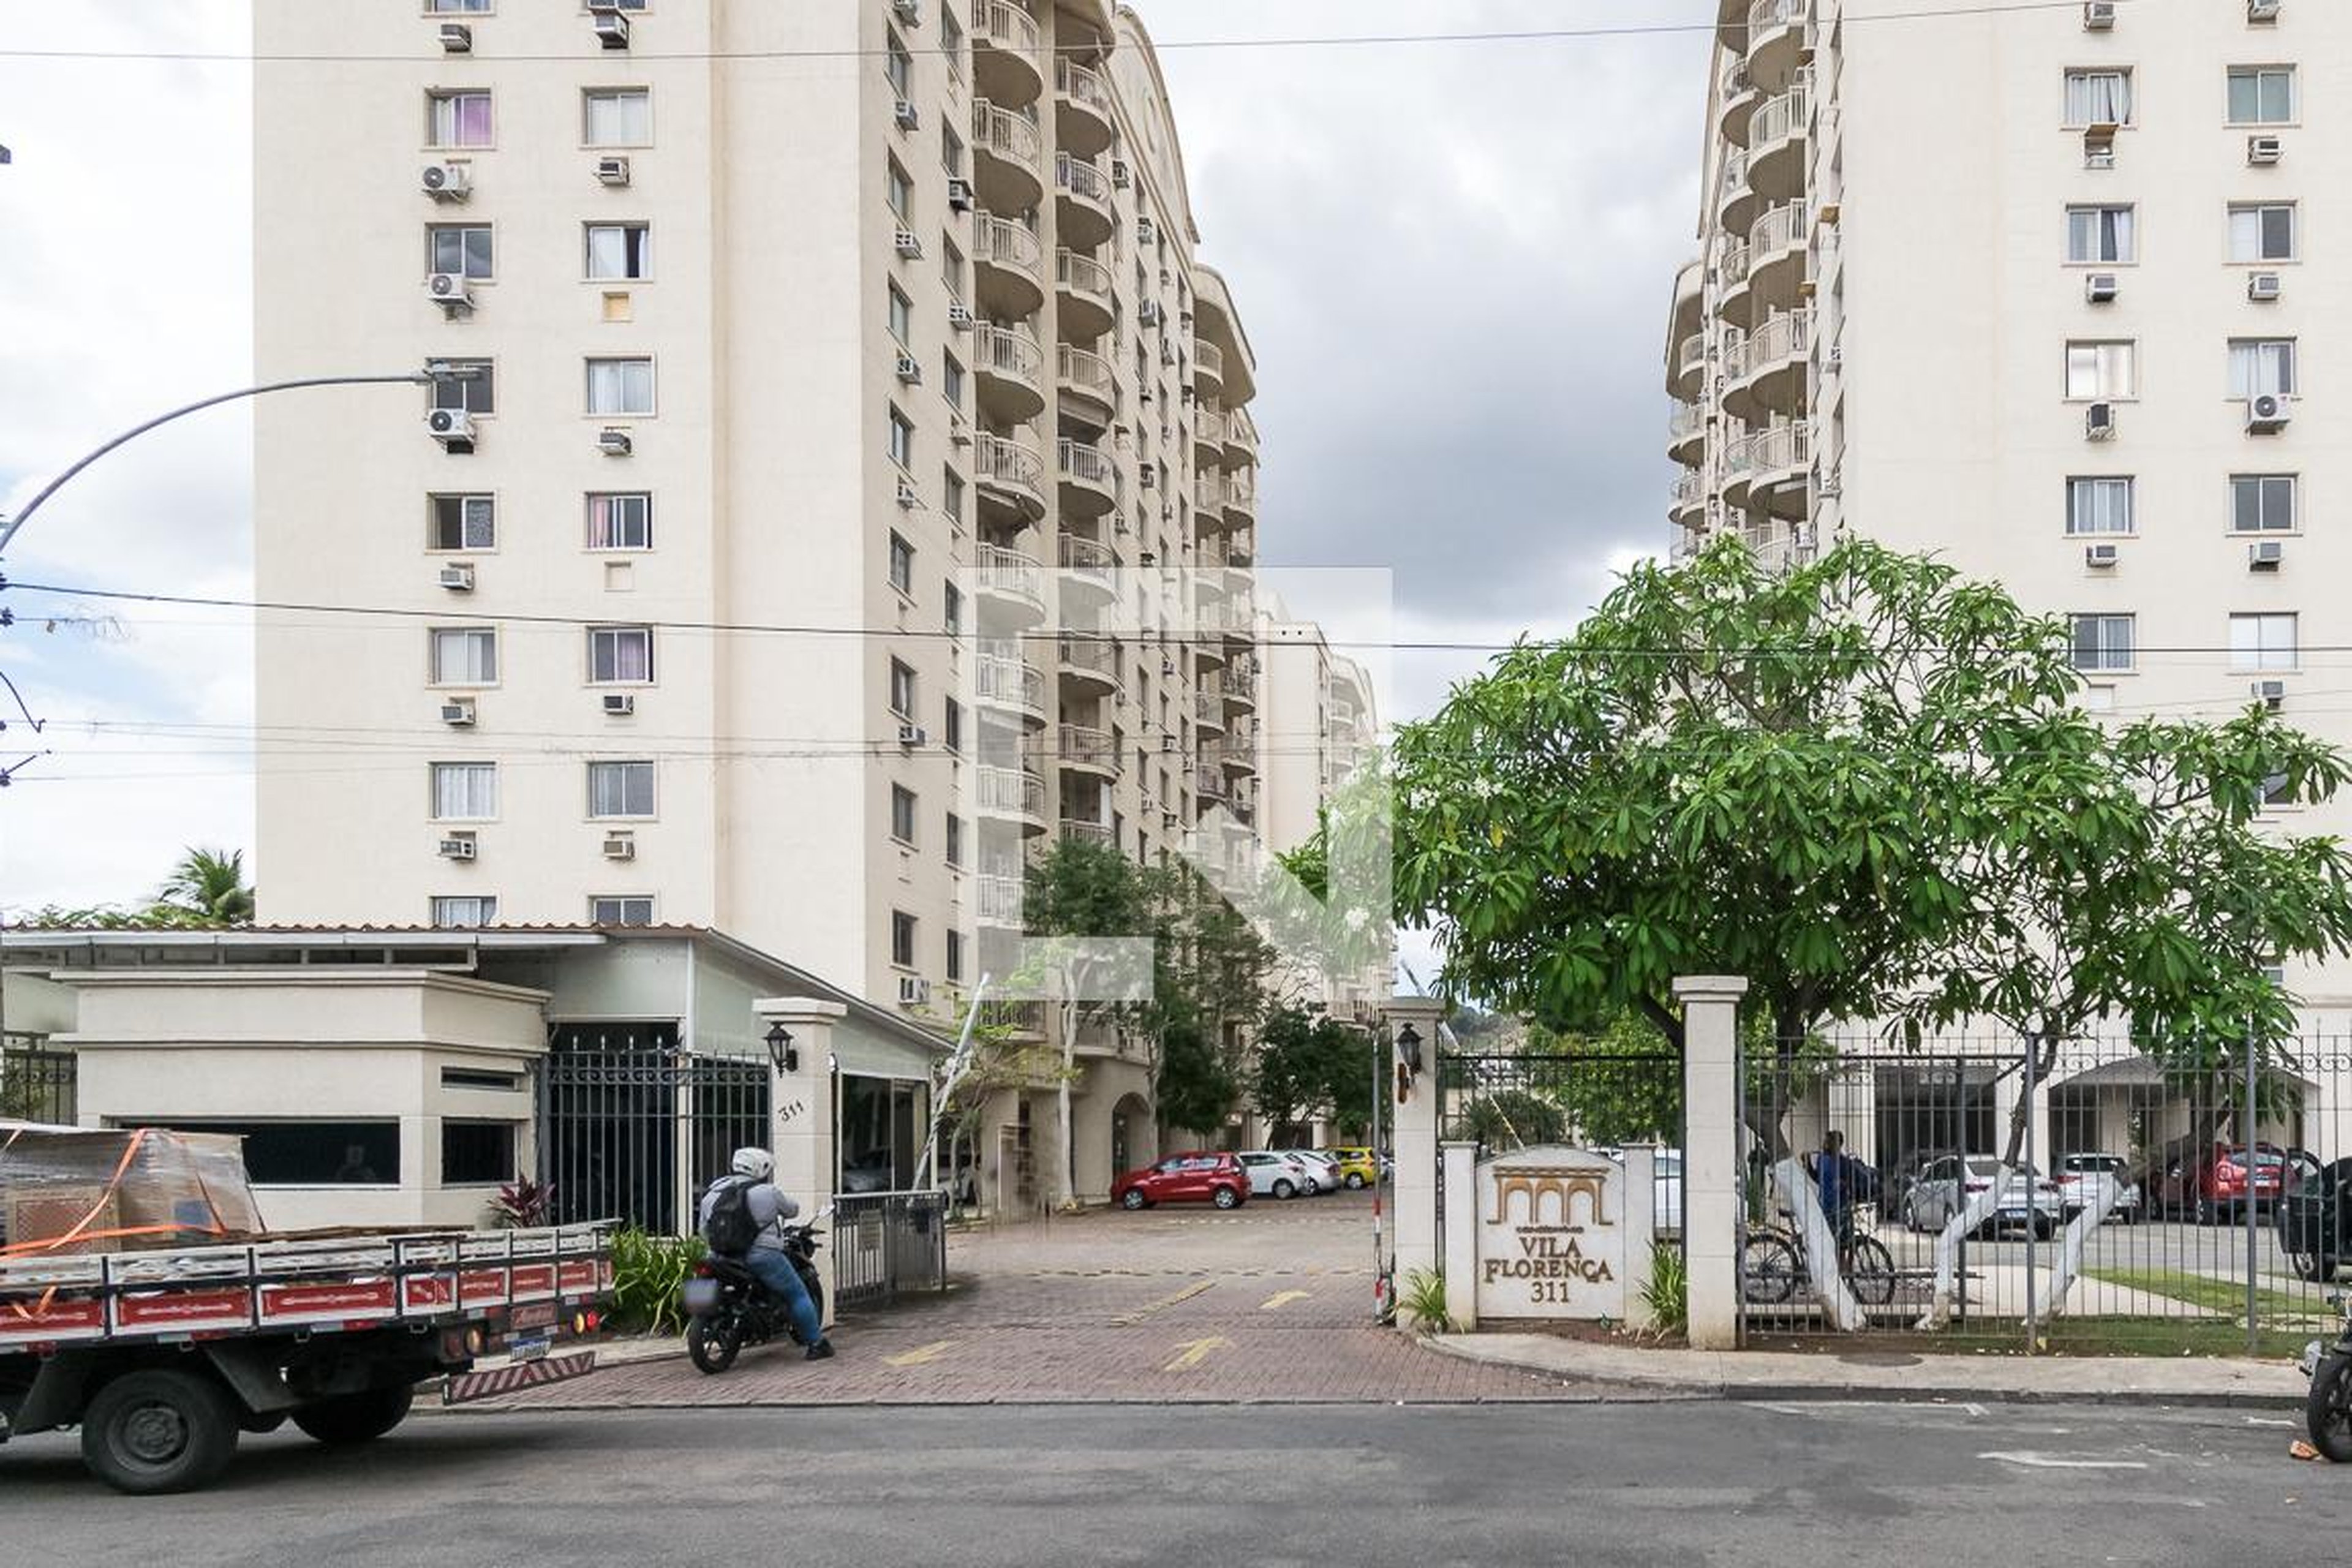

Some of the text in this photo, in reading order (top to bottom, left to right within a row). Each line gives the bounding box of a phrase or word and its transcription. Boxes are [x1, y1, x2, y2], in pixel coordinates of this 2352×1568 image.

[778, 1099, 804, 1121] 311
[1519, 1237, 1582, 1258] VILA
[1484, 1259, 1613, 1283] FLORENÇA
[1531, 1281, 1570, 1303] 311
